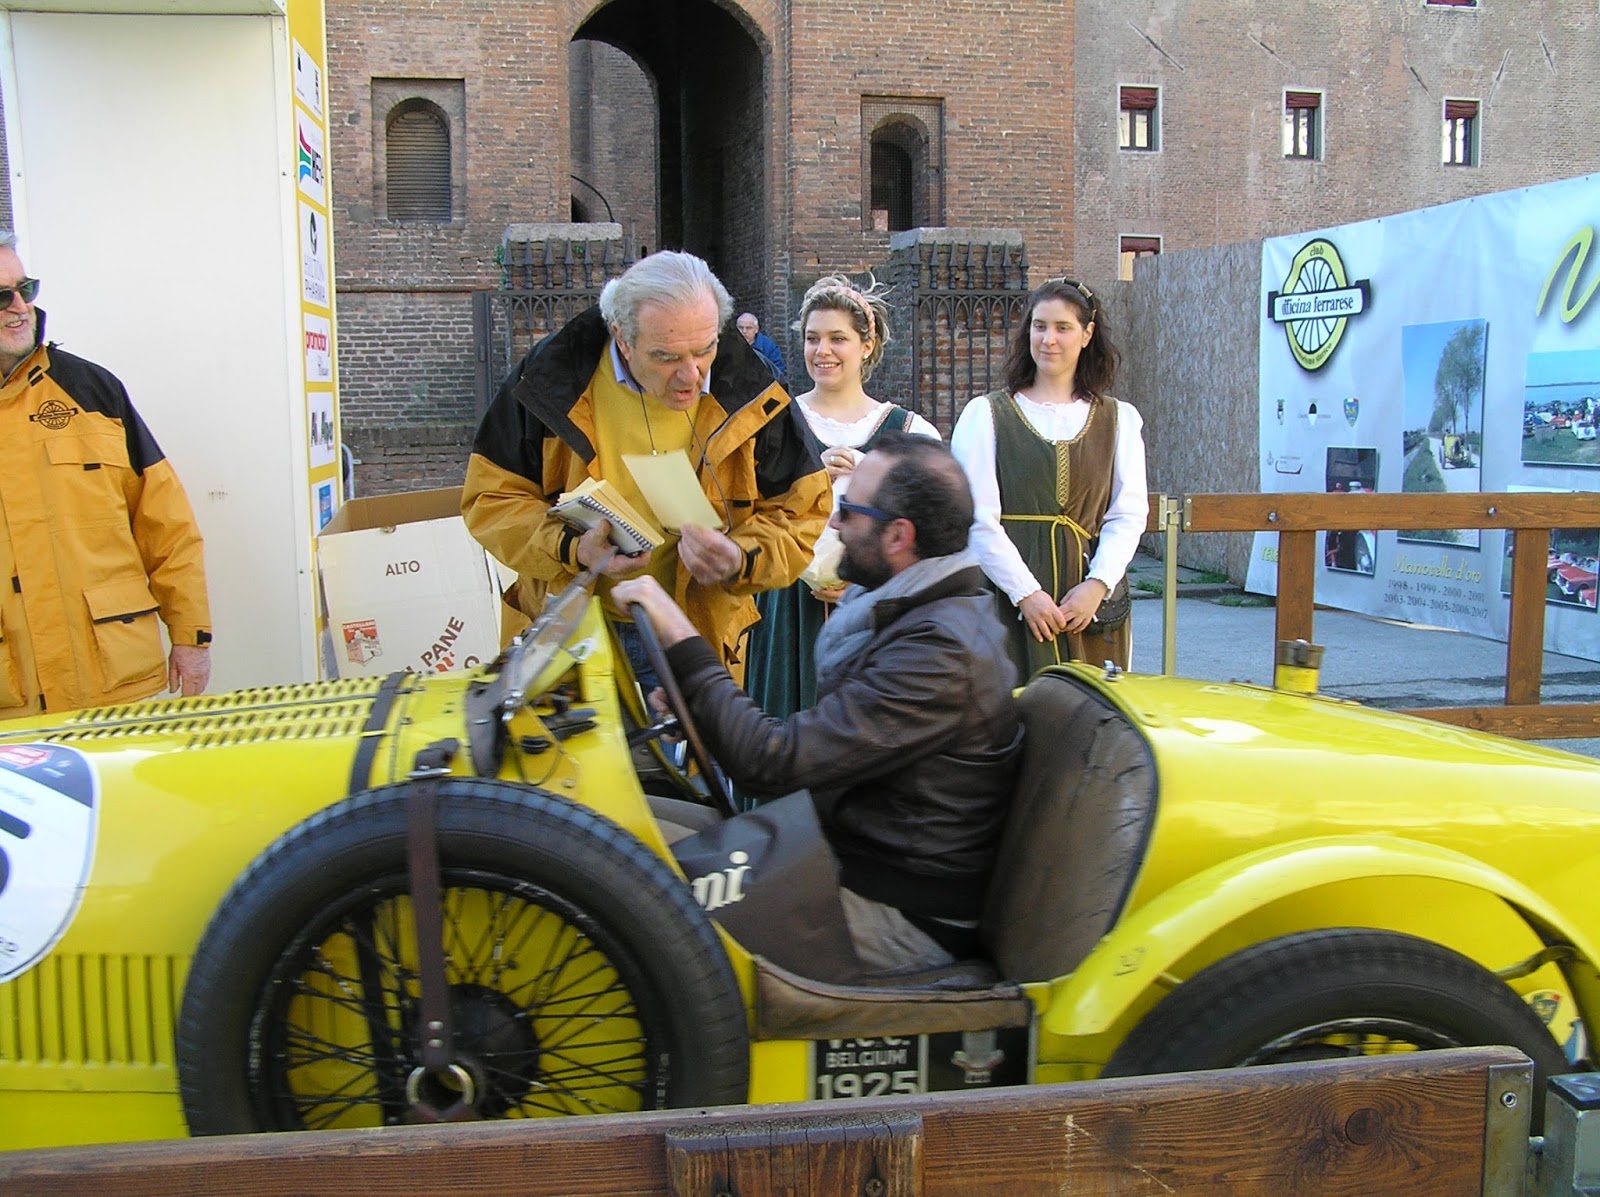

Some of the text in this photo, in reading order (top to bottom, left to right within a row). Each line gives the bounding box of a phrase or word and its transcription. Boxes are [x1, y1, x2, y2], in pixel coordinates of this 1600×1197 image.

[1310, 245, 1324, 257] club
[1313, 296, 1354, 313] ferrarese
[385, 560, 421, 576] ALTO
[1393, 553, 1453, 580] Manovella
[420, 616, 464, 667] PANE
[825, 1049, 907, 1069] BELGIUM
[817, 1070, 919, 1100] 1925
